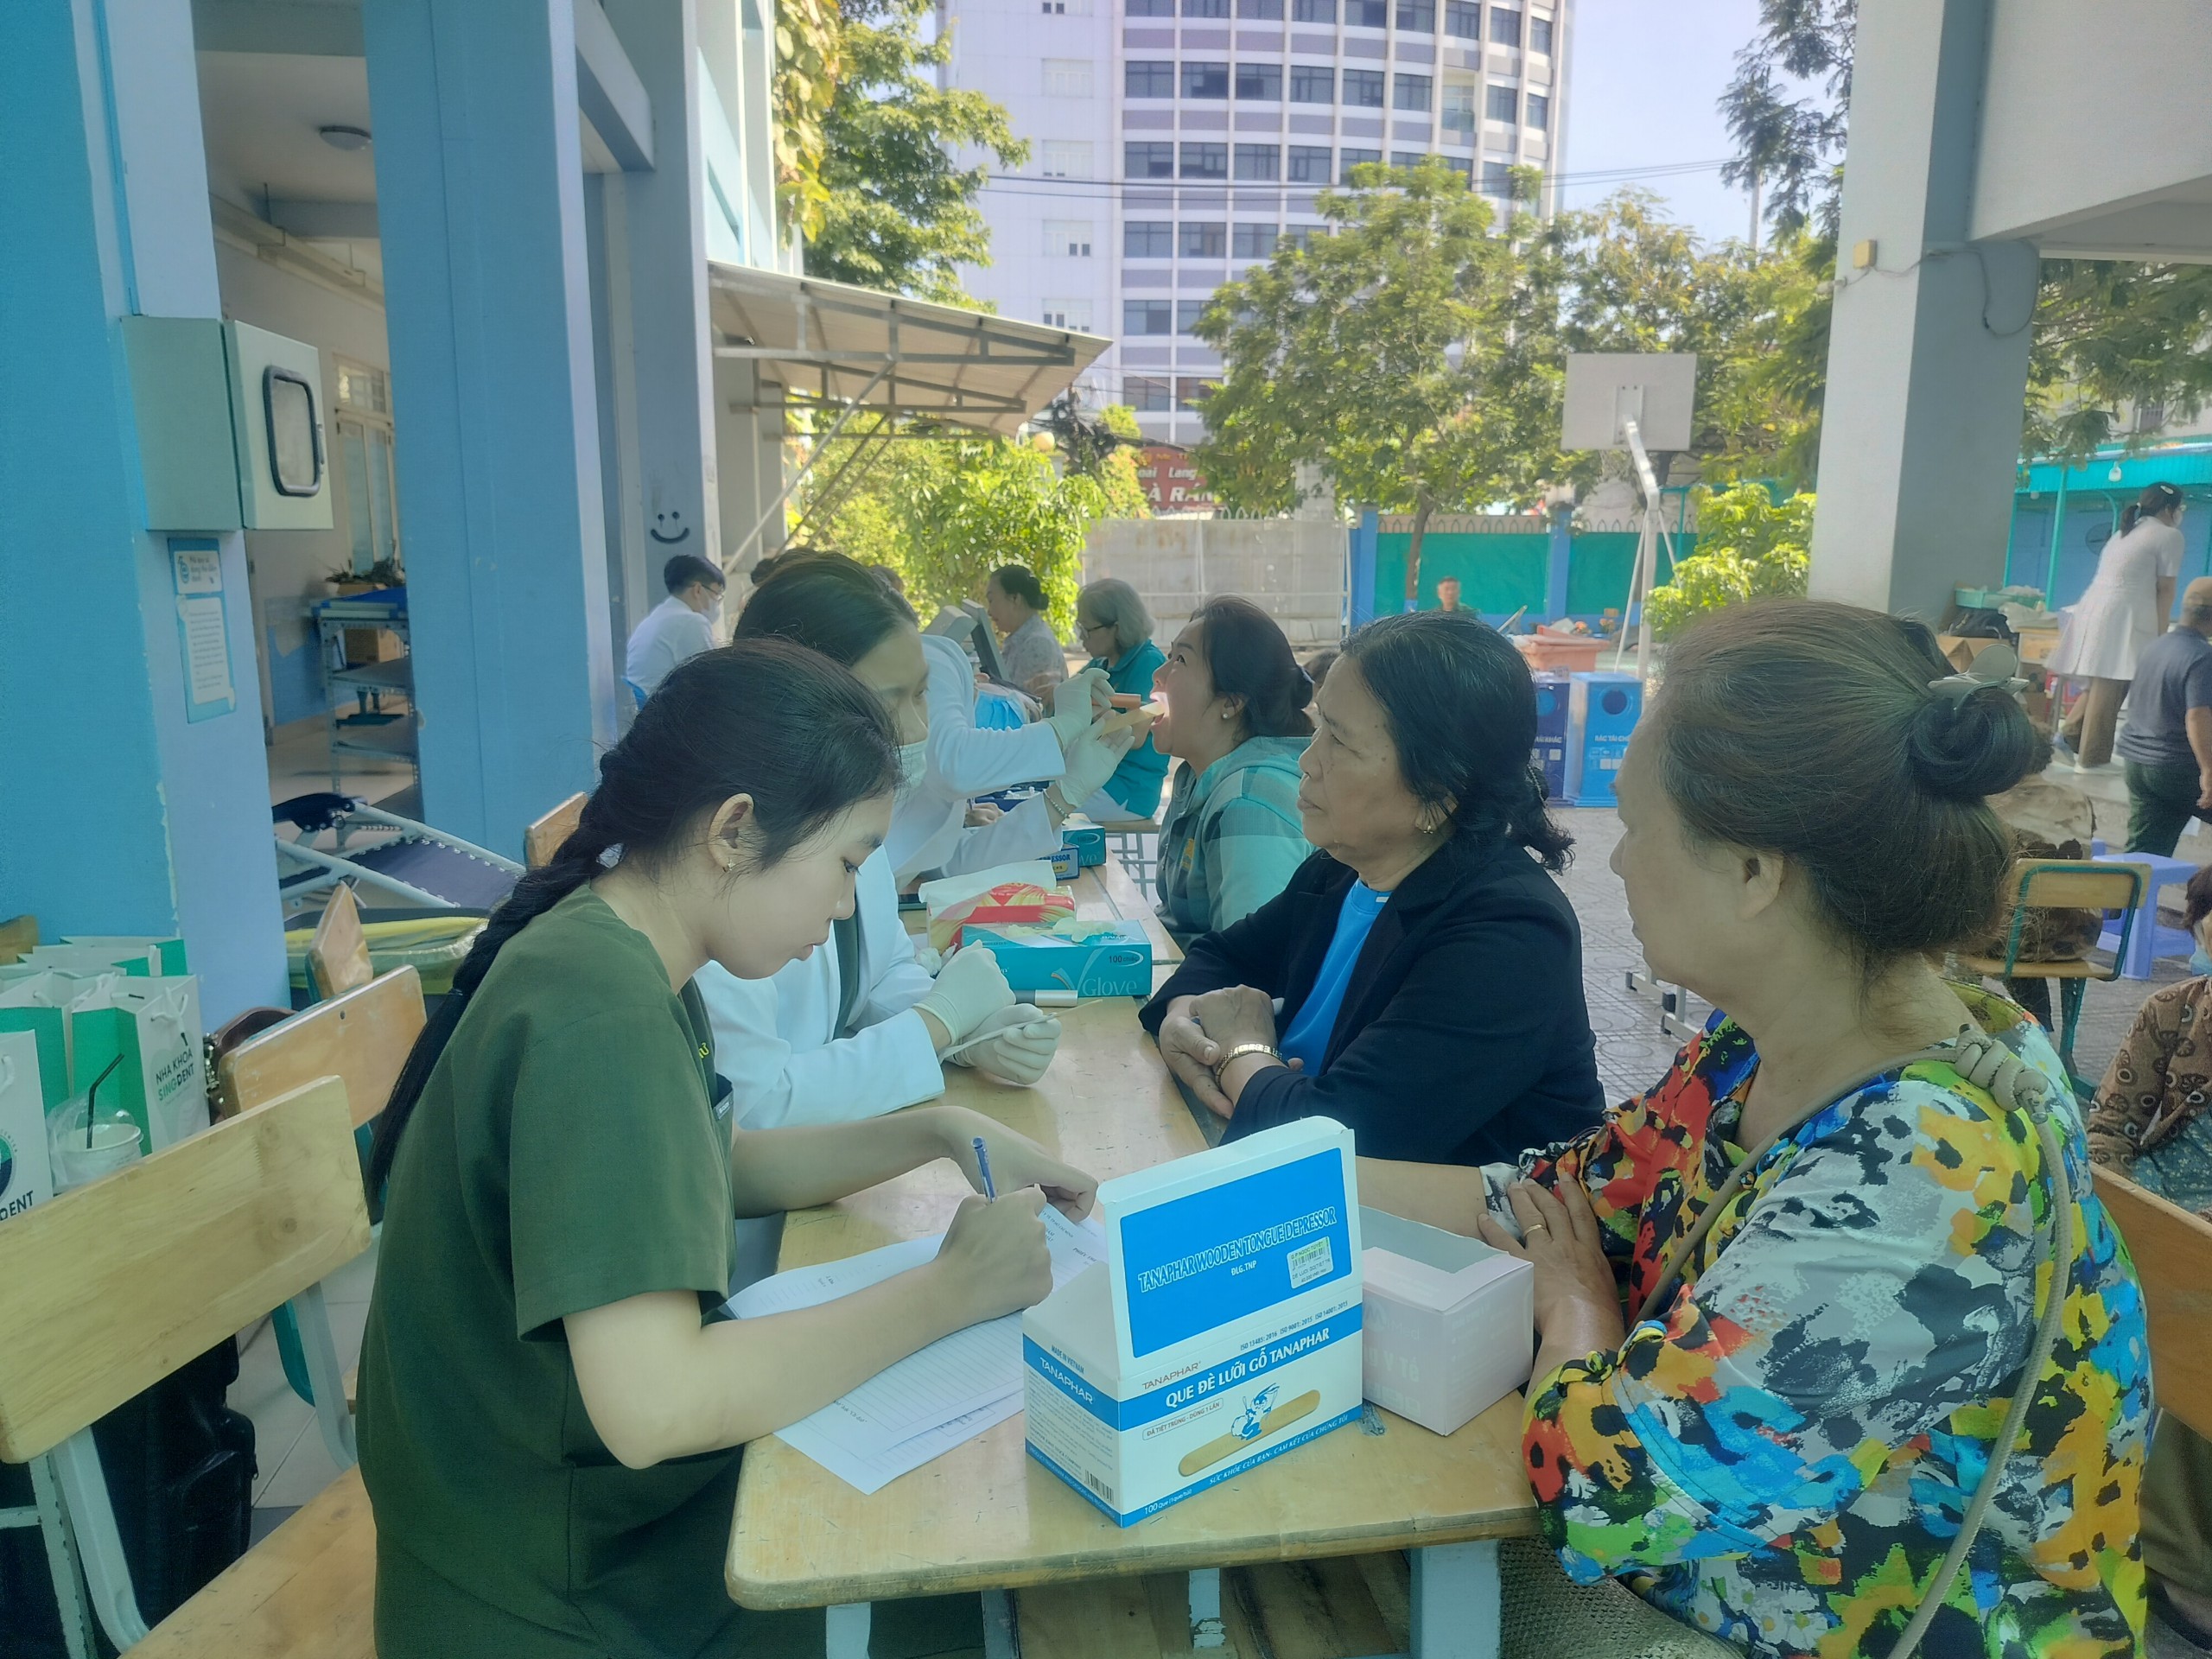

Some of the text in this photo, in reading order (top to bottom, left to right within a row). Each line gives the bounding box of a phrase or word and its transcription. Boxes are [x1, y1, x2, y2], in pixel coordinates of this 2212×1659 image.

[1109, 955, 1122, 963] 100
[156, 1048, 193, 1085] NHA KHOA
[1138, 1206, 1338, 1293] TANAPHAR WOODEN TONGUE DEPRESSOR
[1230, 1260, 1257, 1276] ĐLG.TNP
[1240, 1341, 1249, 1351] ISO
[1266, 1330, 1278, 1342] 2016
[1280, 1326, 1288, 1335] ISO
[1051, 1344, 1062, 1357] MADE
[1067, 1357, 1084, 1374] VIETNAM
[1166, 1327, 1330, 1408] QUE ĐÈ LƯỠI GỖ TANAPHAR
[1039, 1357, 1093, 1405] TANAPHAR
[1147, 1427, 1156, 1437] ĐÃ
[1144, 1502, 1158, 1516] 100
